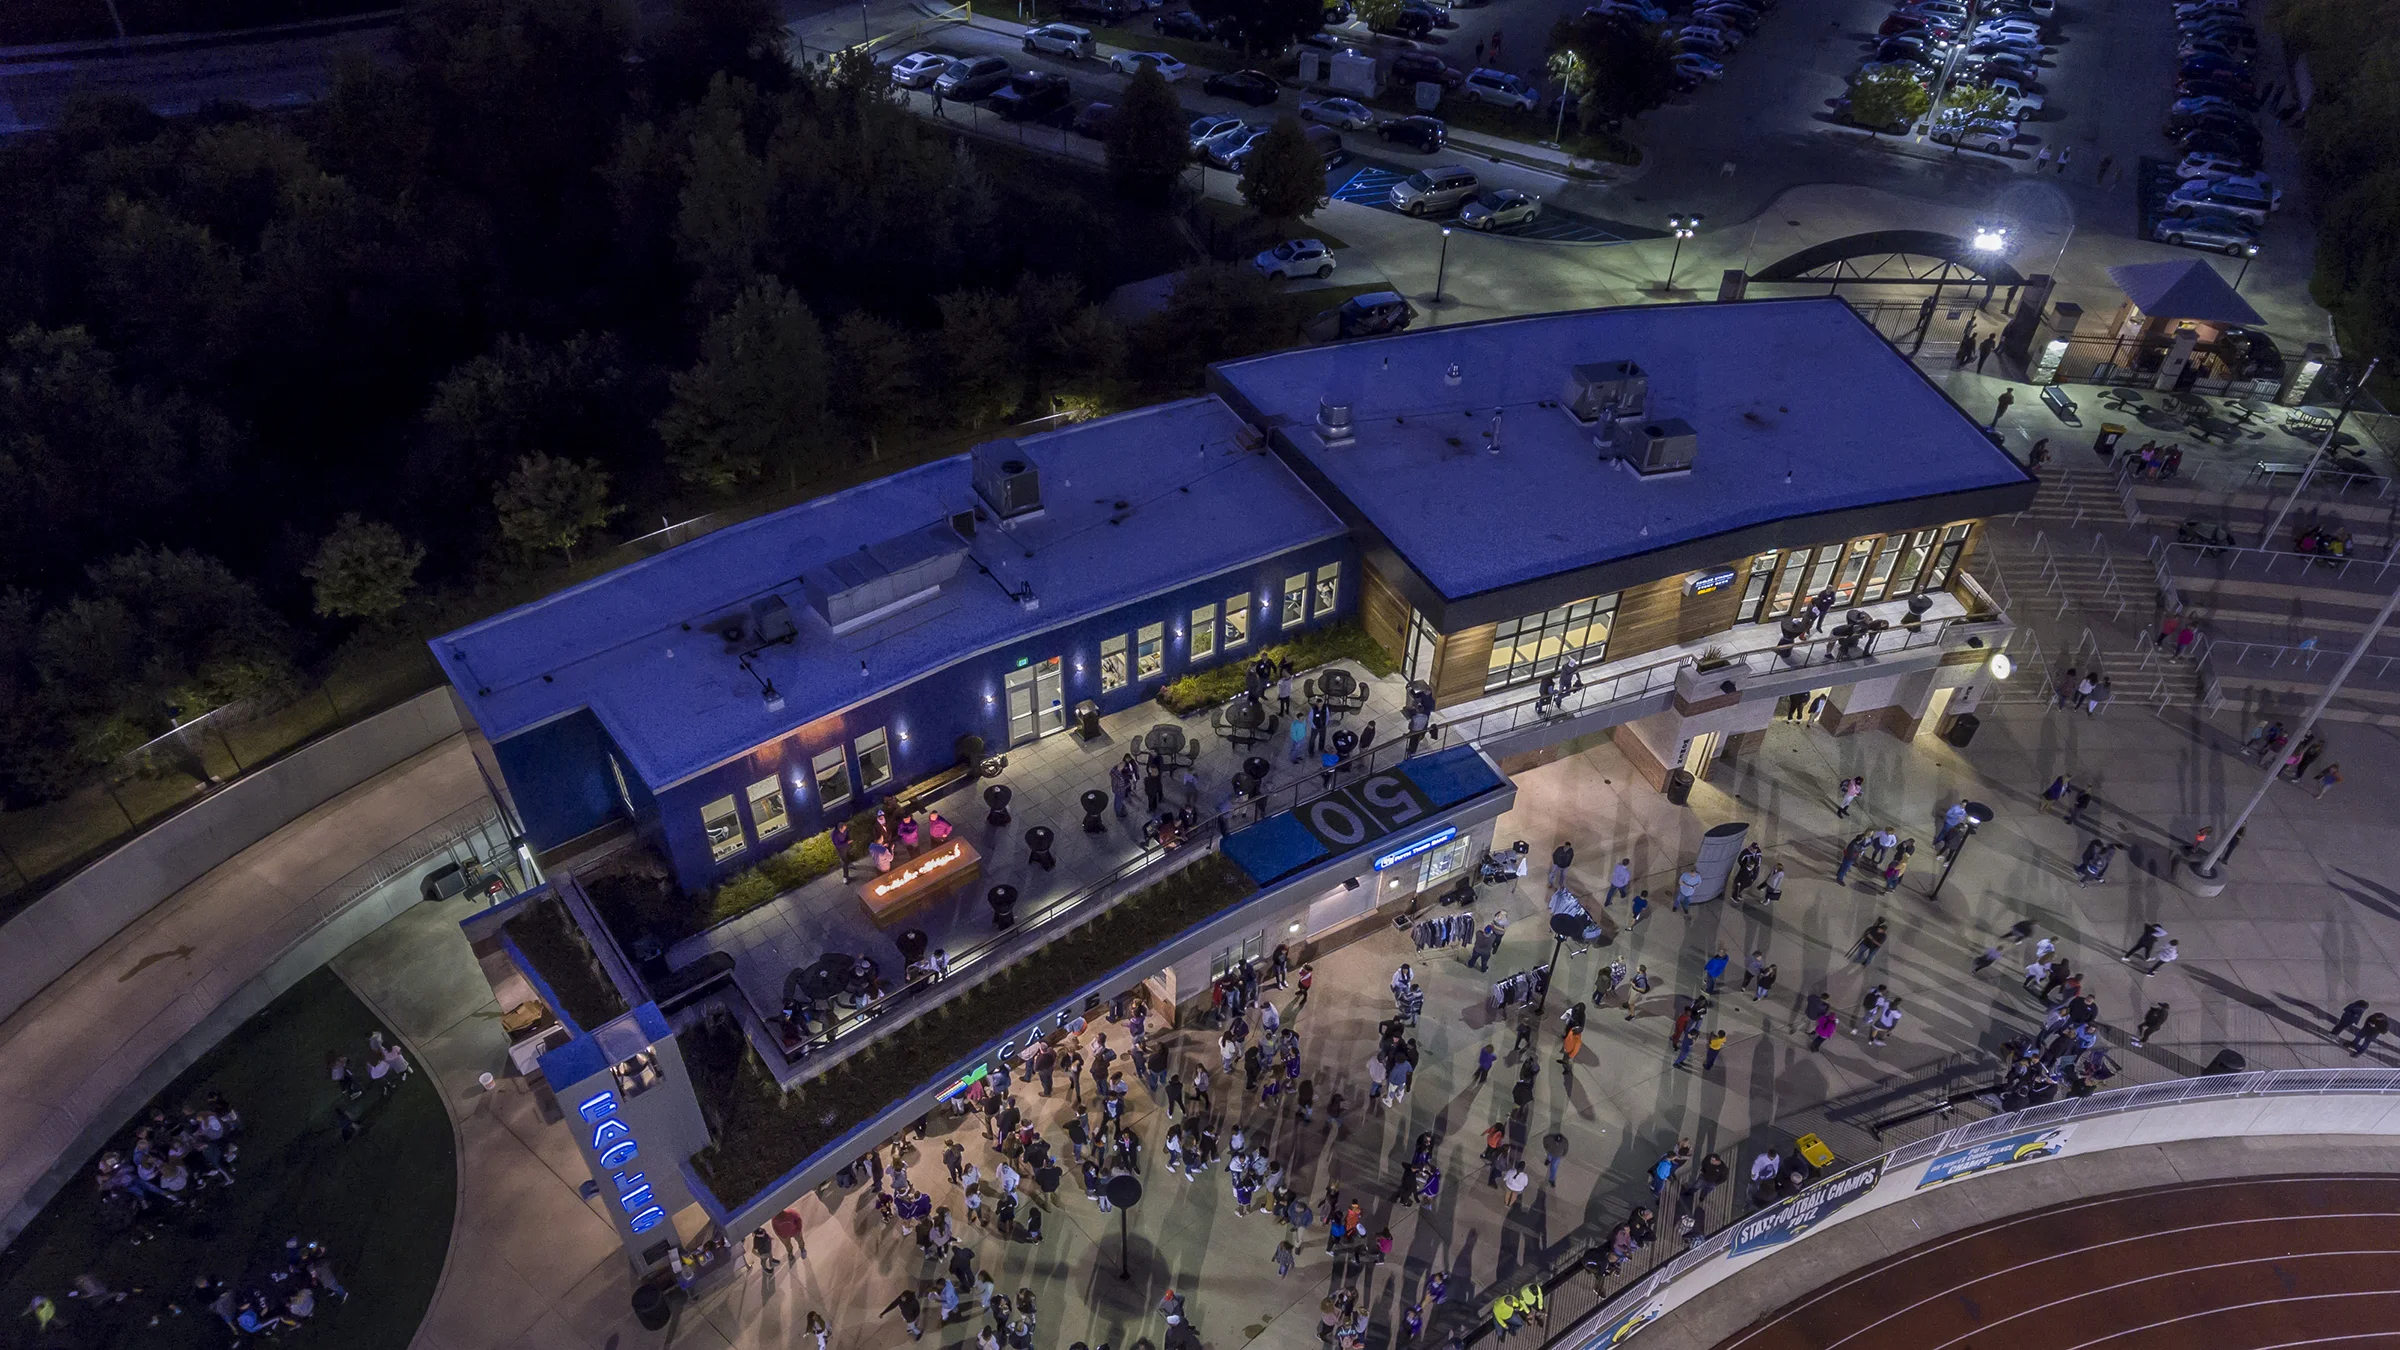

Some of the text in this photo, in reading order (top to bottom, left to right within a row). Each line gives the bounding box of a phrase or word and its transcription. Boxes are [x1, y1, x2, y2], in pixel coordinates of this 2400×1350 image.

[997, 993, 1100, 1060] CAFE
[578, 1090, 665, 1235] EAGLES
[1947, 1156, 1993, 1175] CHAMPS
[1773, 1189, 1827, 1227] FOOTBALL
[1827, 1168, 1876, 1201] CHAMPS
[1786, 1207, 1819, 1230] 2012
